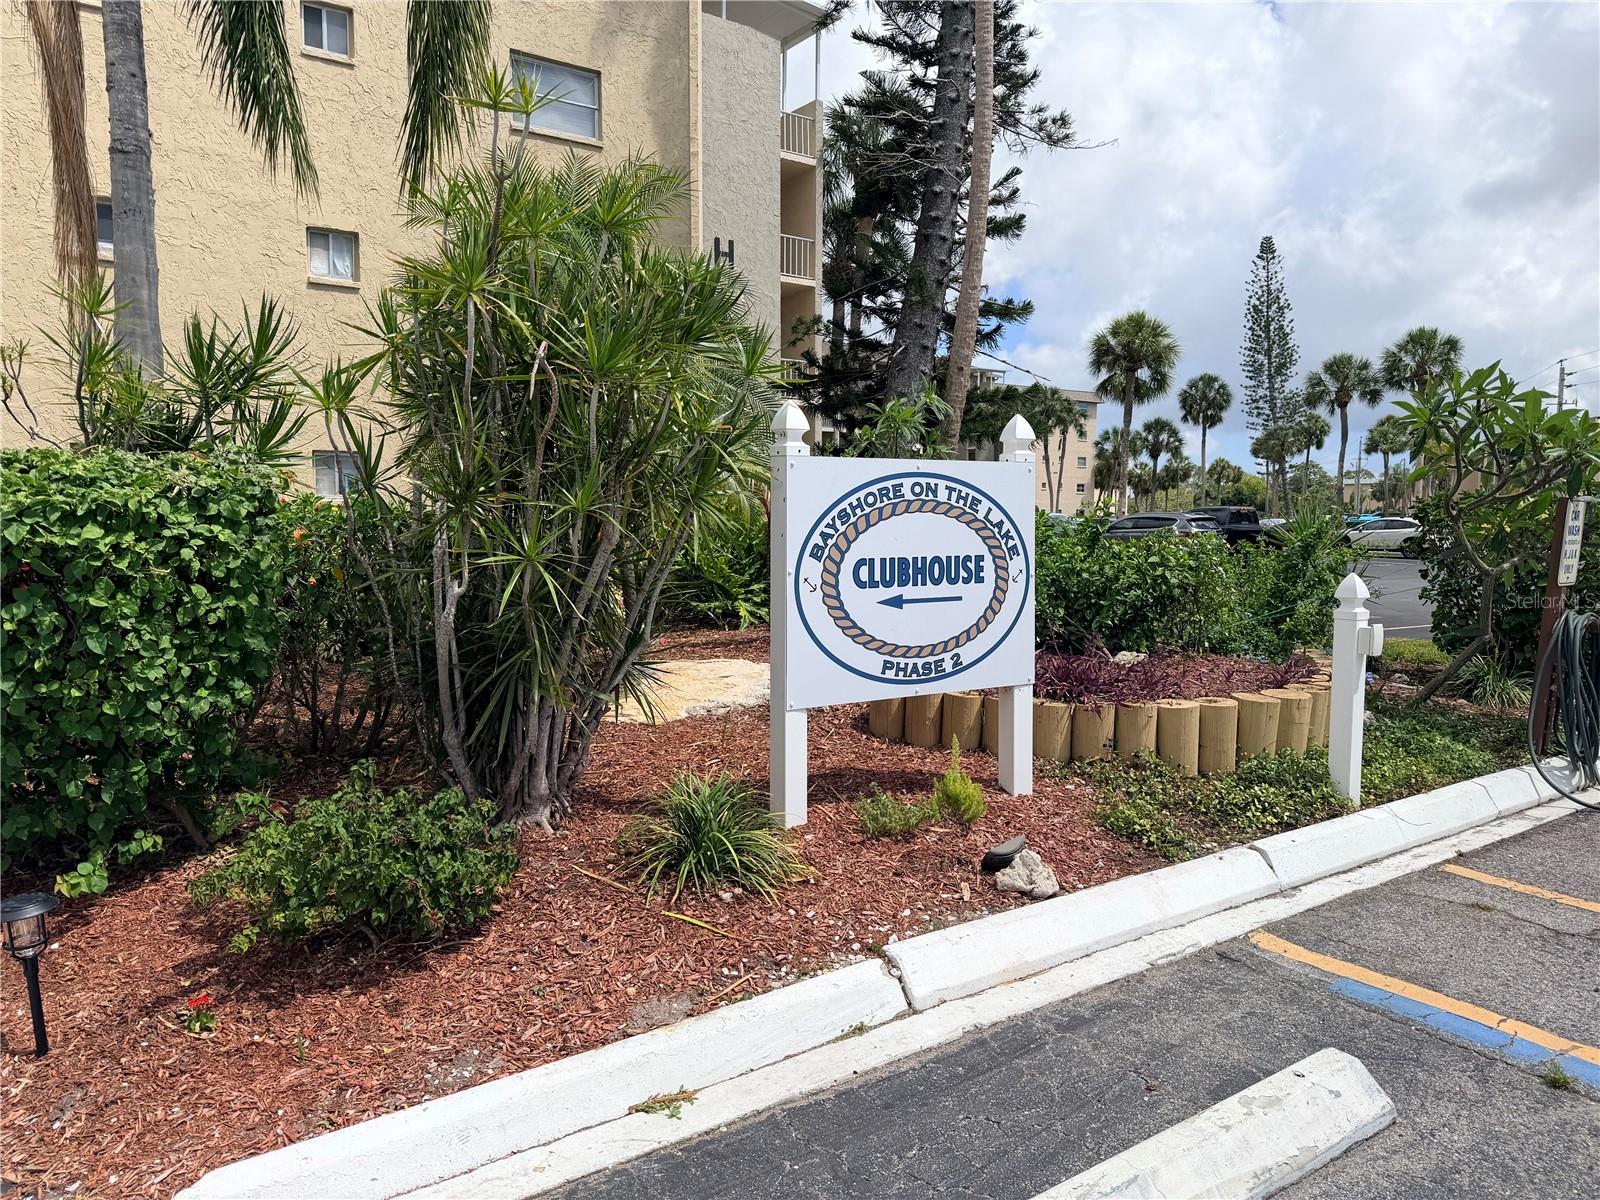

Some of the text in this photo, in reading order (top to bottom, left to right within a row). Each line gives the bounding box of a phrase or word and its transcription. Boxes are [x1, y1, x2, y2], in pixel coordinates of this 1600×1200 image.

[714, 236, 735, 270] H
[808, 481, 1020, 563] BAYSHORE ON THE LAKE
[1567, 525, 1581, 536] WASH
[852, 554, 985, 590] CLUBHOUSE
[880, 652, 963, 678] PHASE 2
